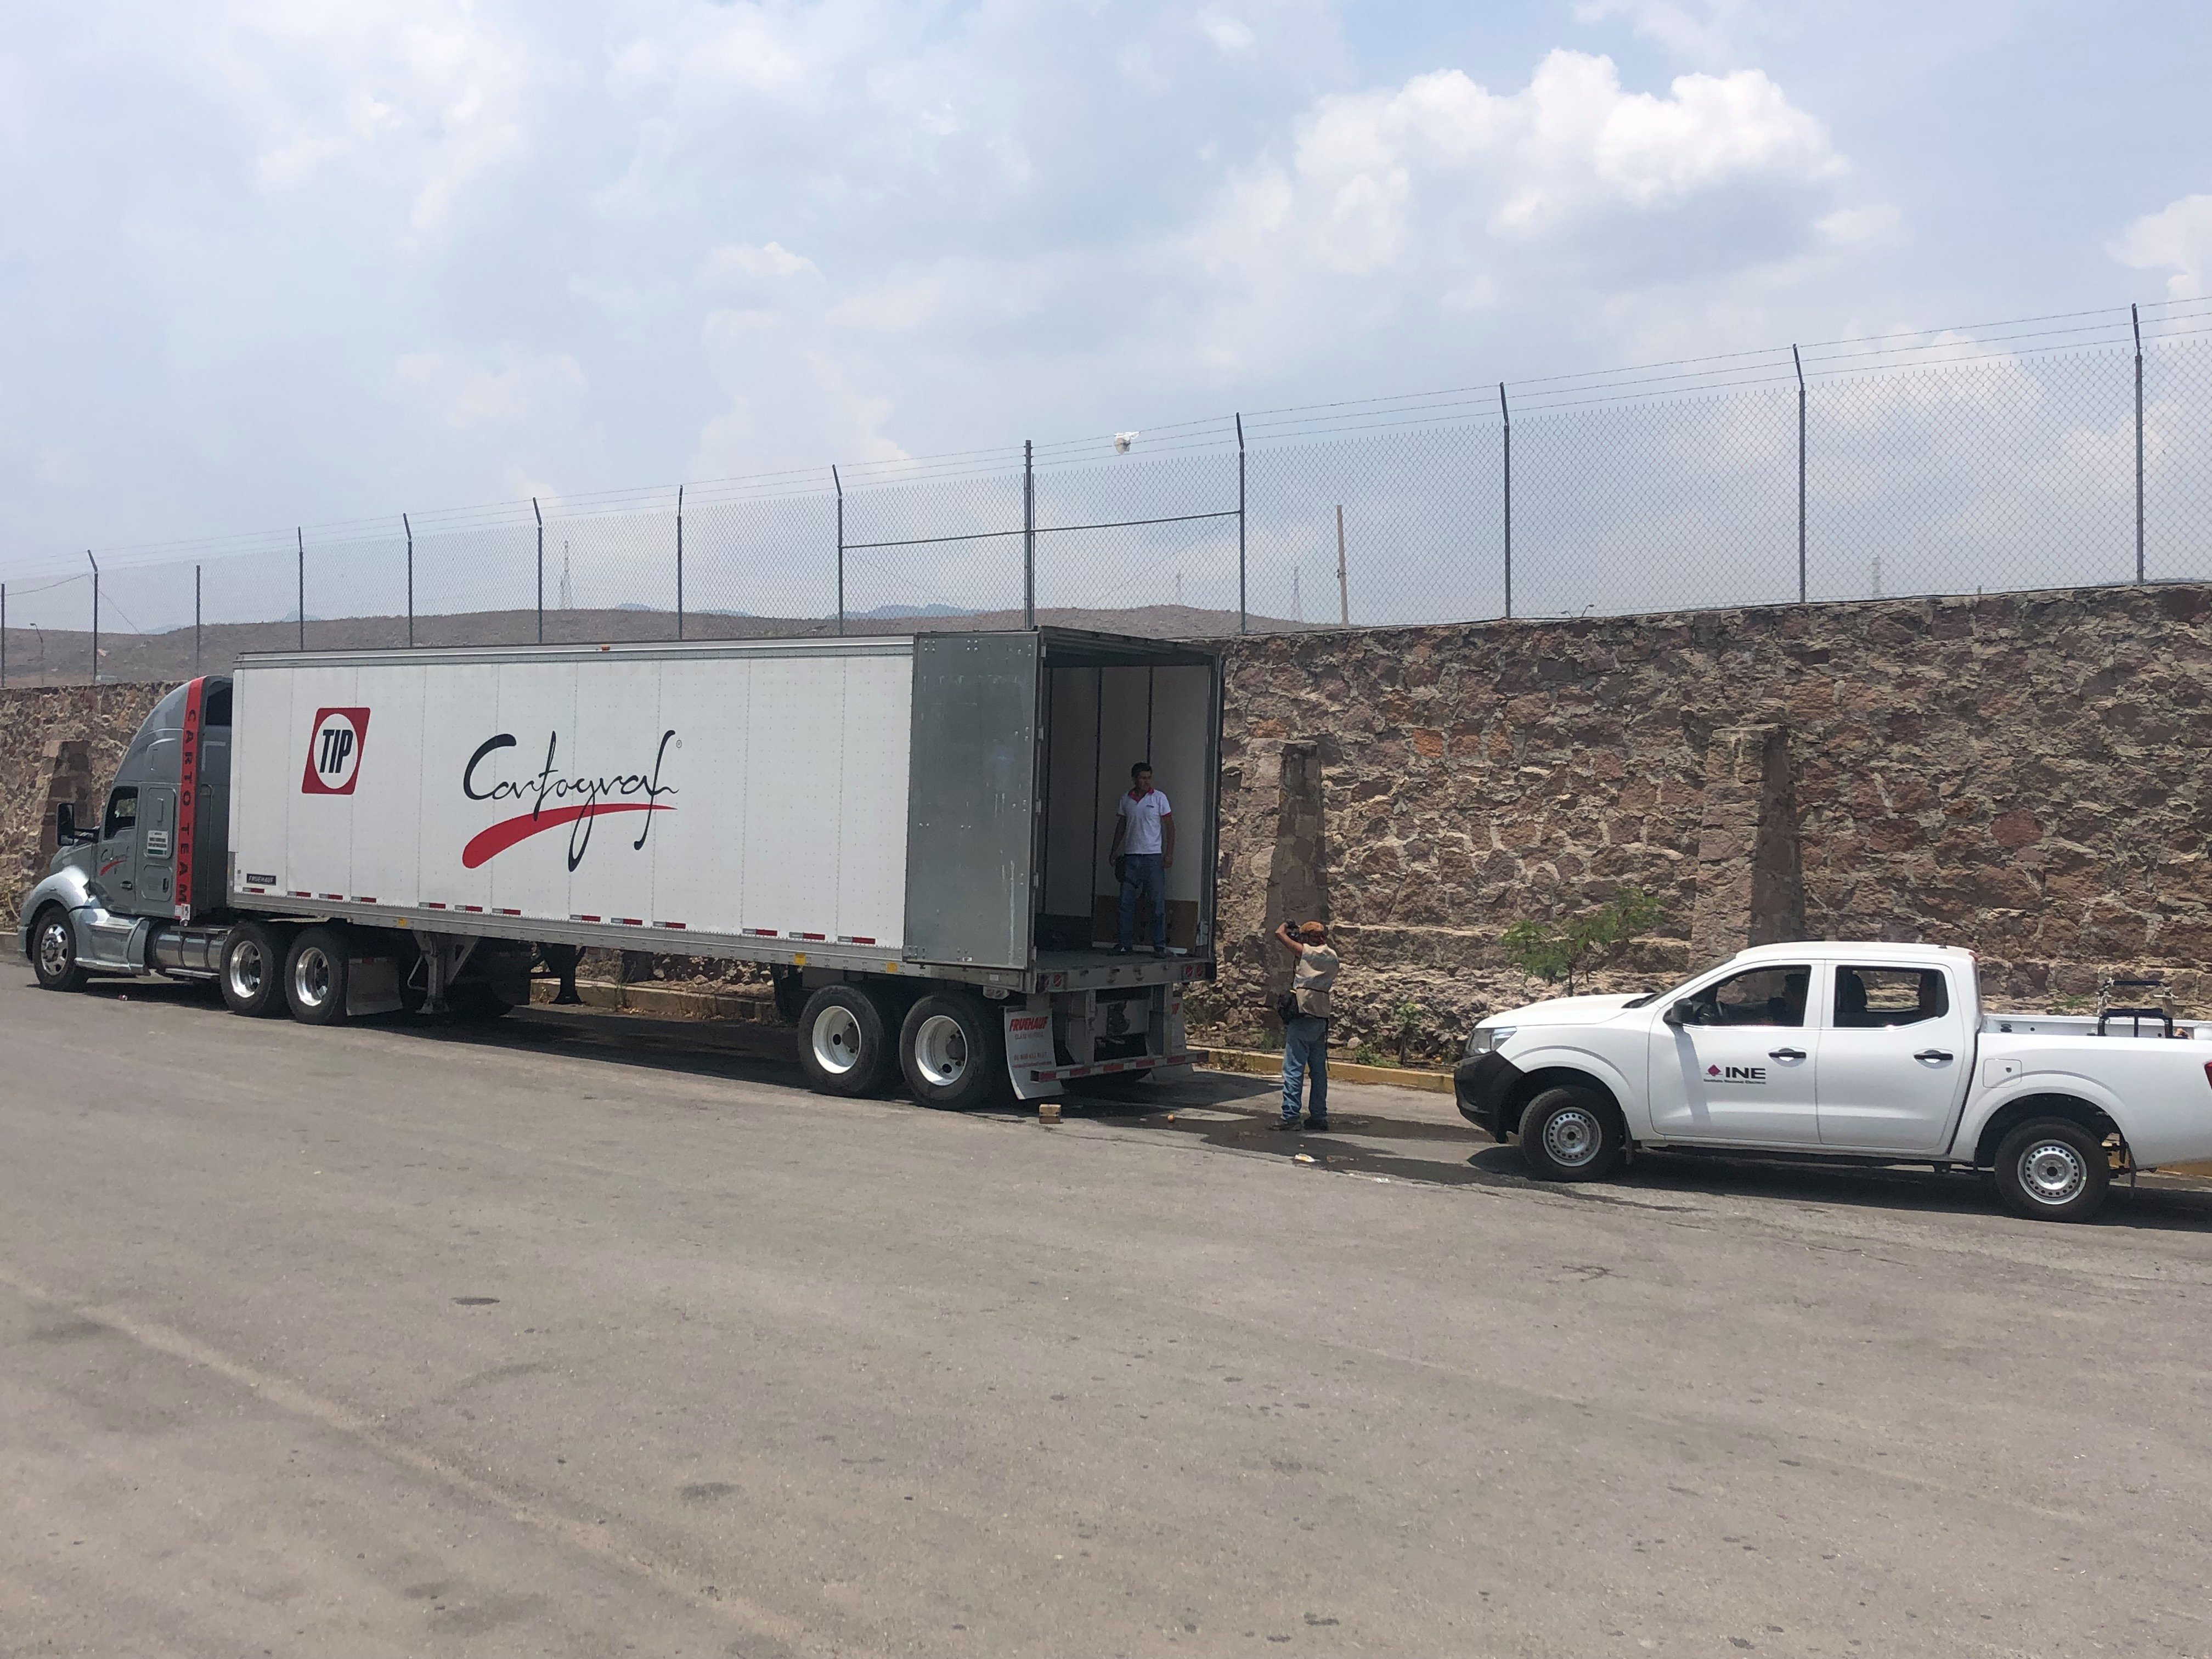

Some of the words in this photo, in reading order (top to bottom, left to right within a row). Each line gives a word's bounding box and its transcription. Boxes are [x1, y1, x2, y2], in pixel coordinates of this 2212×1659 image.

[319, 729, 354, 774] TIP
[463, 730, 679, 872] Cartograf
[1010, 1016, 1048, 1031] FRUEHAUF
[1725, 1066, 1766, 1079] INE
